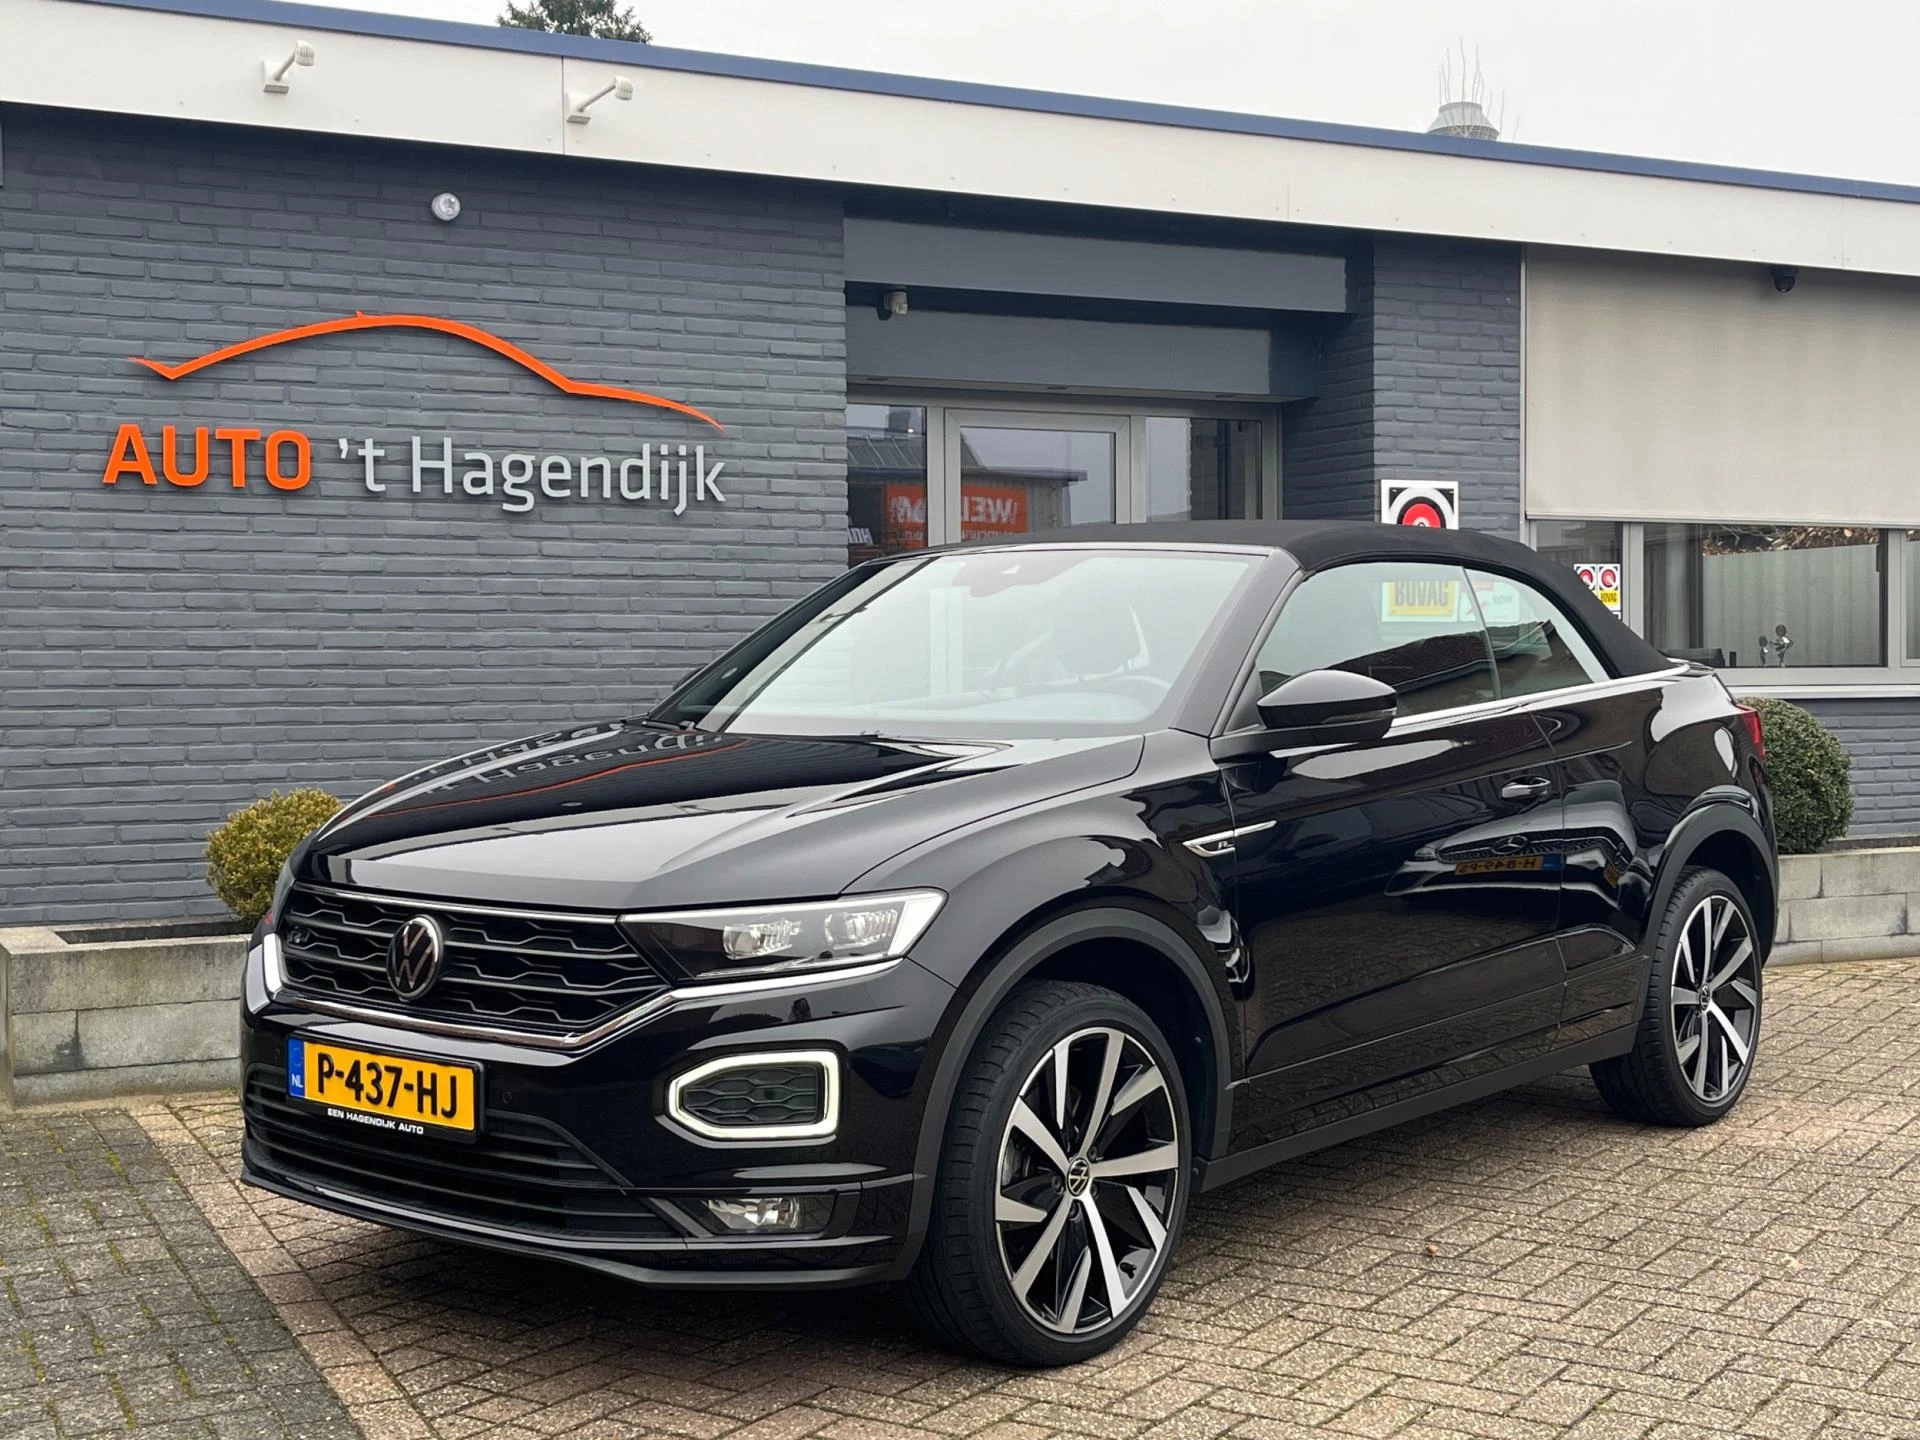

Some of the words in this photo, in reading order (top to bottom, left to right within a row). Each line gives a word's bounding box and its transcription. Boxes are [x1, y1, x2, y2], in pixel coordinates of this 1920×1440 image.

[102, 423, 311, 491] AUTO
[338, 436, 387, 492] 't
[411, 435, 727, 516] Hagendijk
[291, 1073, 304, 1089] NL
[317, 1052, 458, 1119] P-437-HJ
[327, 1108, 345, 1119] EEN
[346, 1112, 396, 1130] HAGENDIJK
[398, 1122, 424, 1135] AUTO
